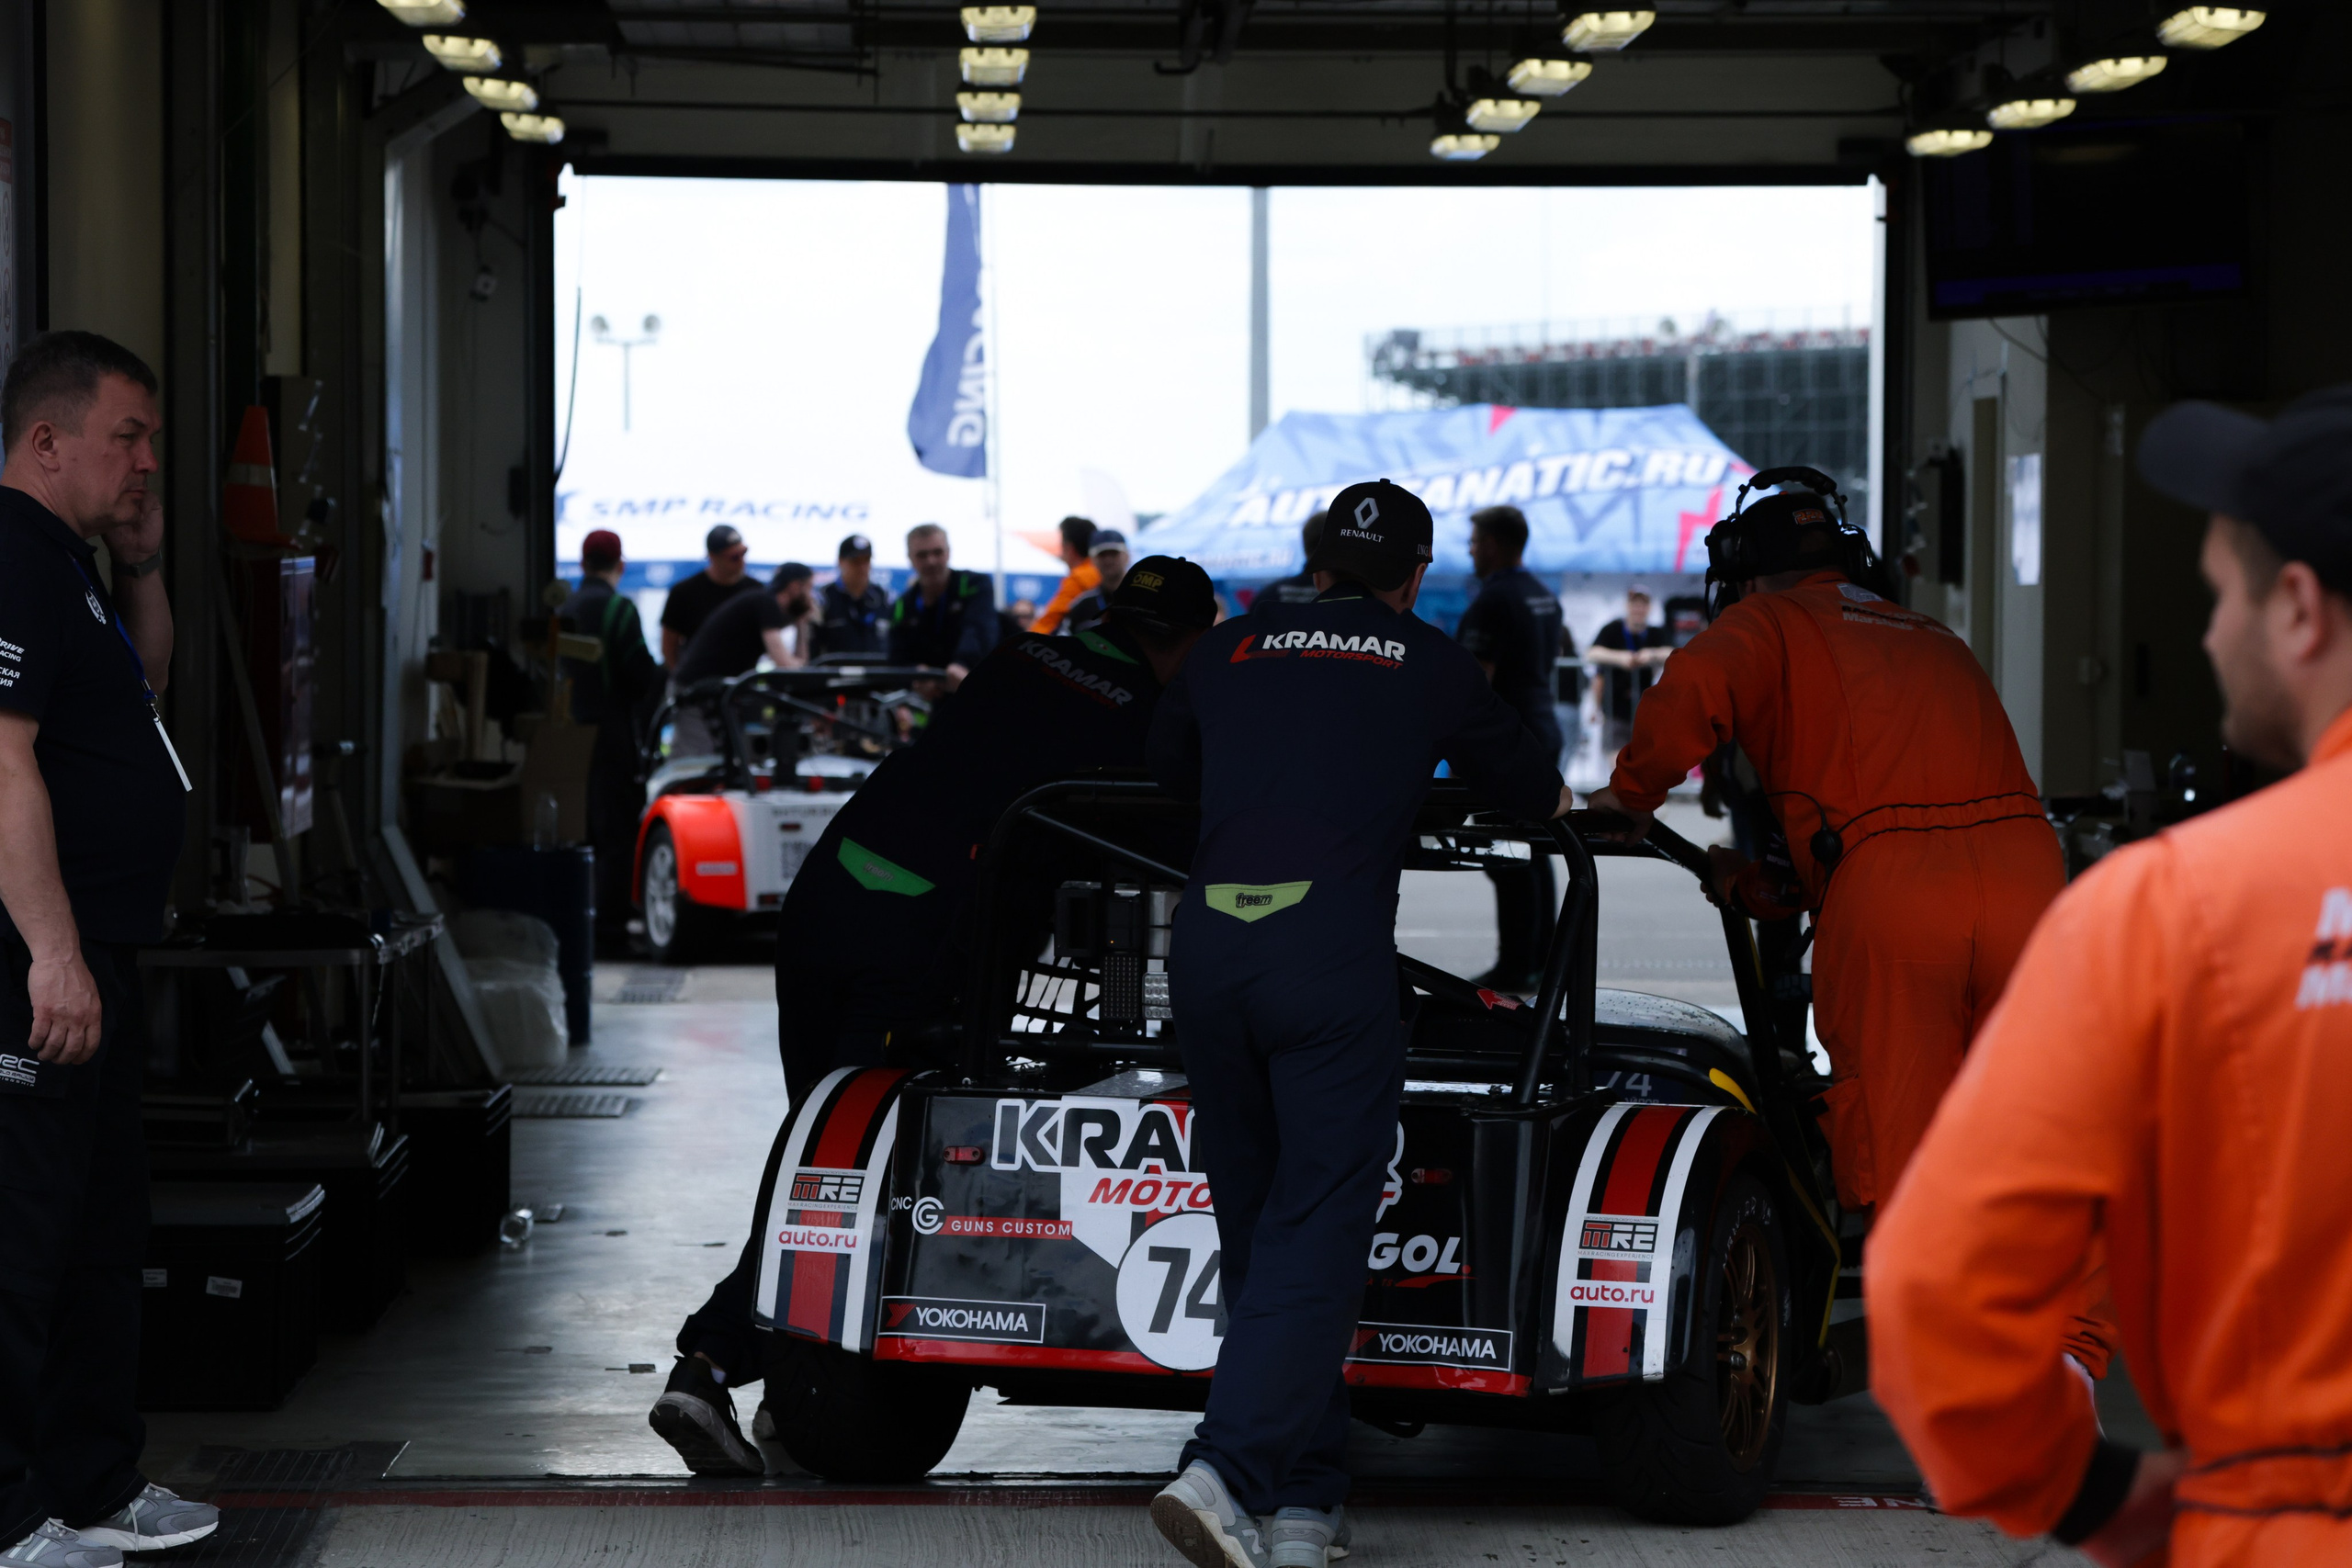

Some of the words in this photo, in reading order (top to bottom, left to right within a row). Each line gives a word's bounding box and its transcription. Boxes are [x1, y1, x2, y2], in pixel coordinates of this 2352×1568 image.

[700, 496, 871, 521] RACING
[1340, 528, 1385, 543] RENAULT
[1132, 574, 1164, 589] OMP
[1262, 630, 1406, 662] KRAMAR
[1299, 649, 1404, 670] MOTORSPORT
[1017, 639, 1134, 706] KRAMAR
[1236, 893, 1272, 908] freem
[890, 1197, 912, 1211] CNC
[951, 1220, 994, 1233] GUNS
[1001, 1222, 1070, 1235] CUSTOM
[778, 1230, 857, 1248] auto.ru
[1148, 1246, 1229, 1337] 74
[1570, 1285, 1654, 1303] auto.ru
[916, 1307, 1028, 1332] YOKOHAMA
[1379, 1333, 1497, 1359] YOKOHAMA
